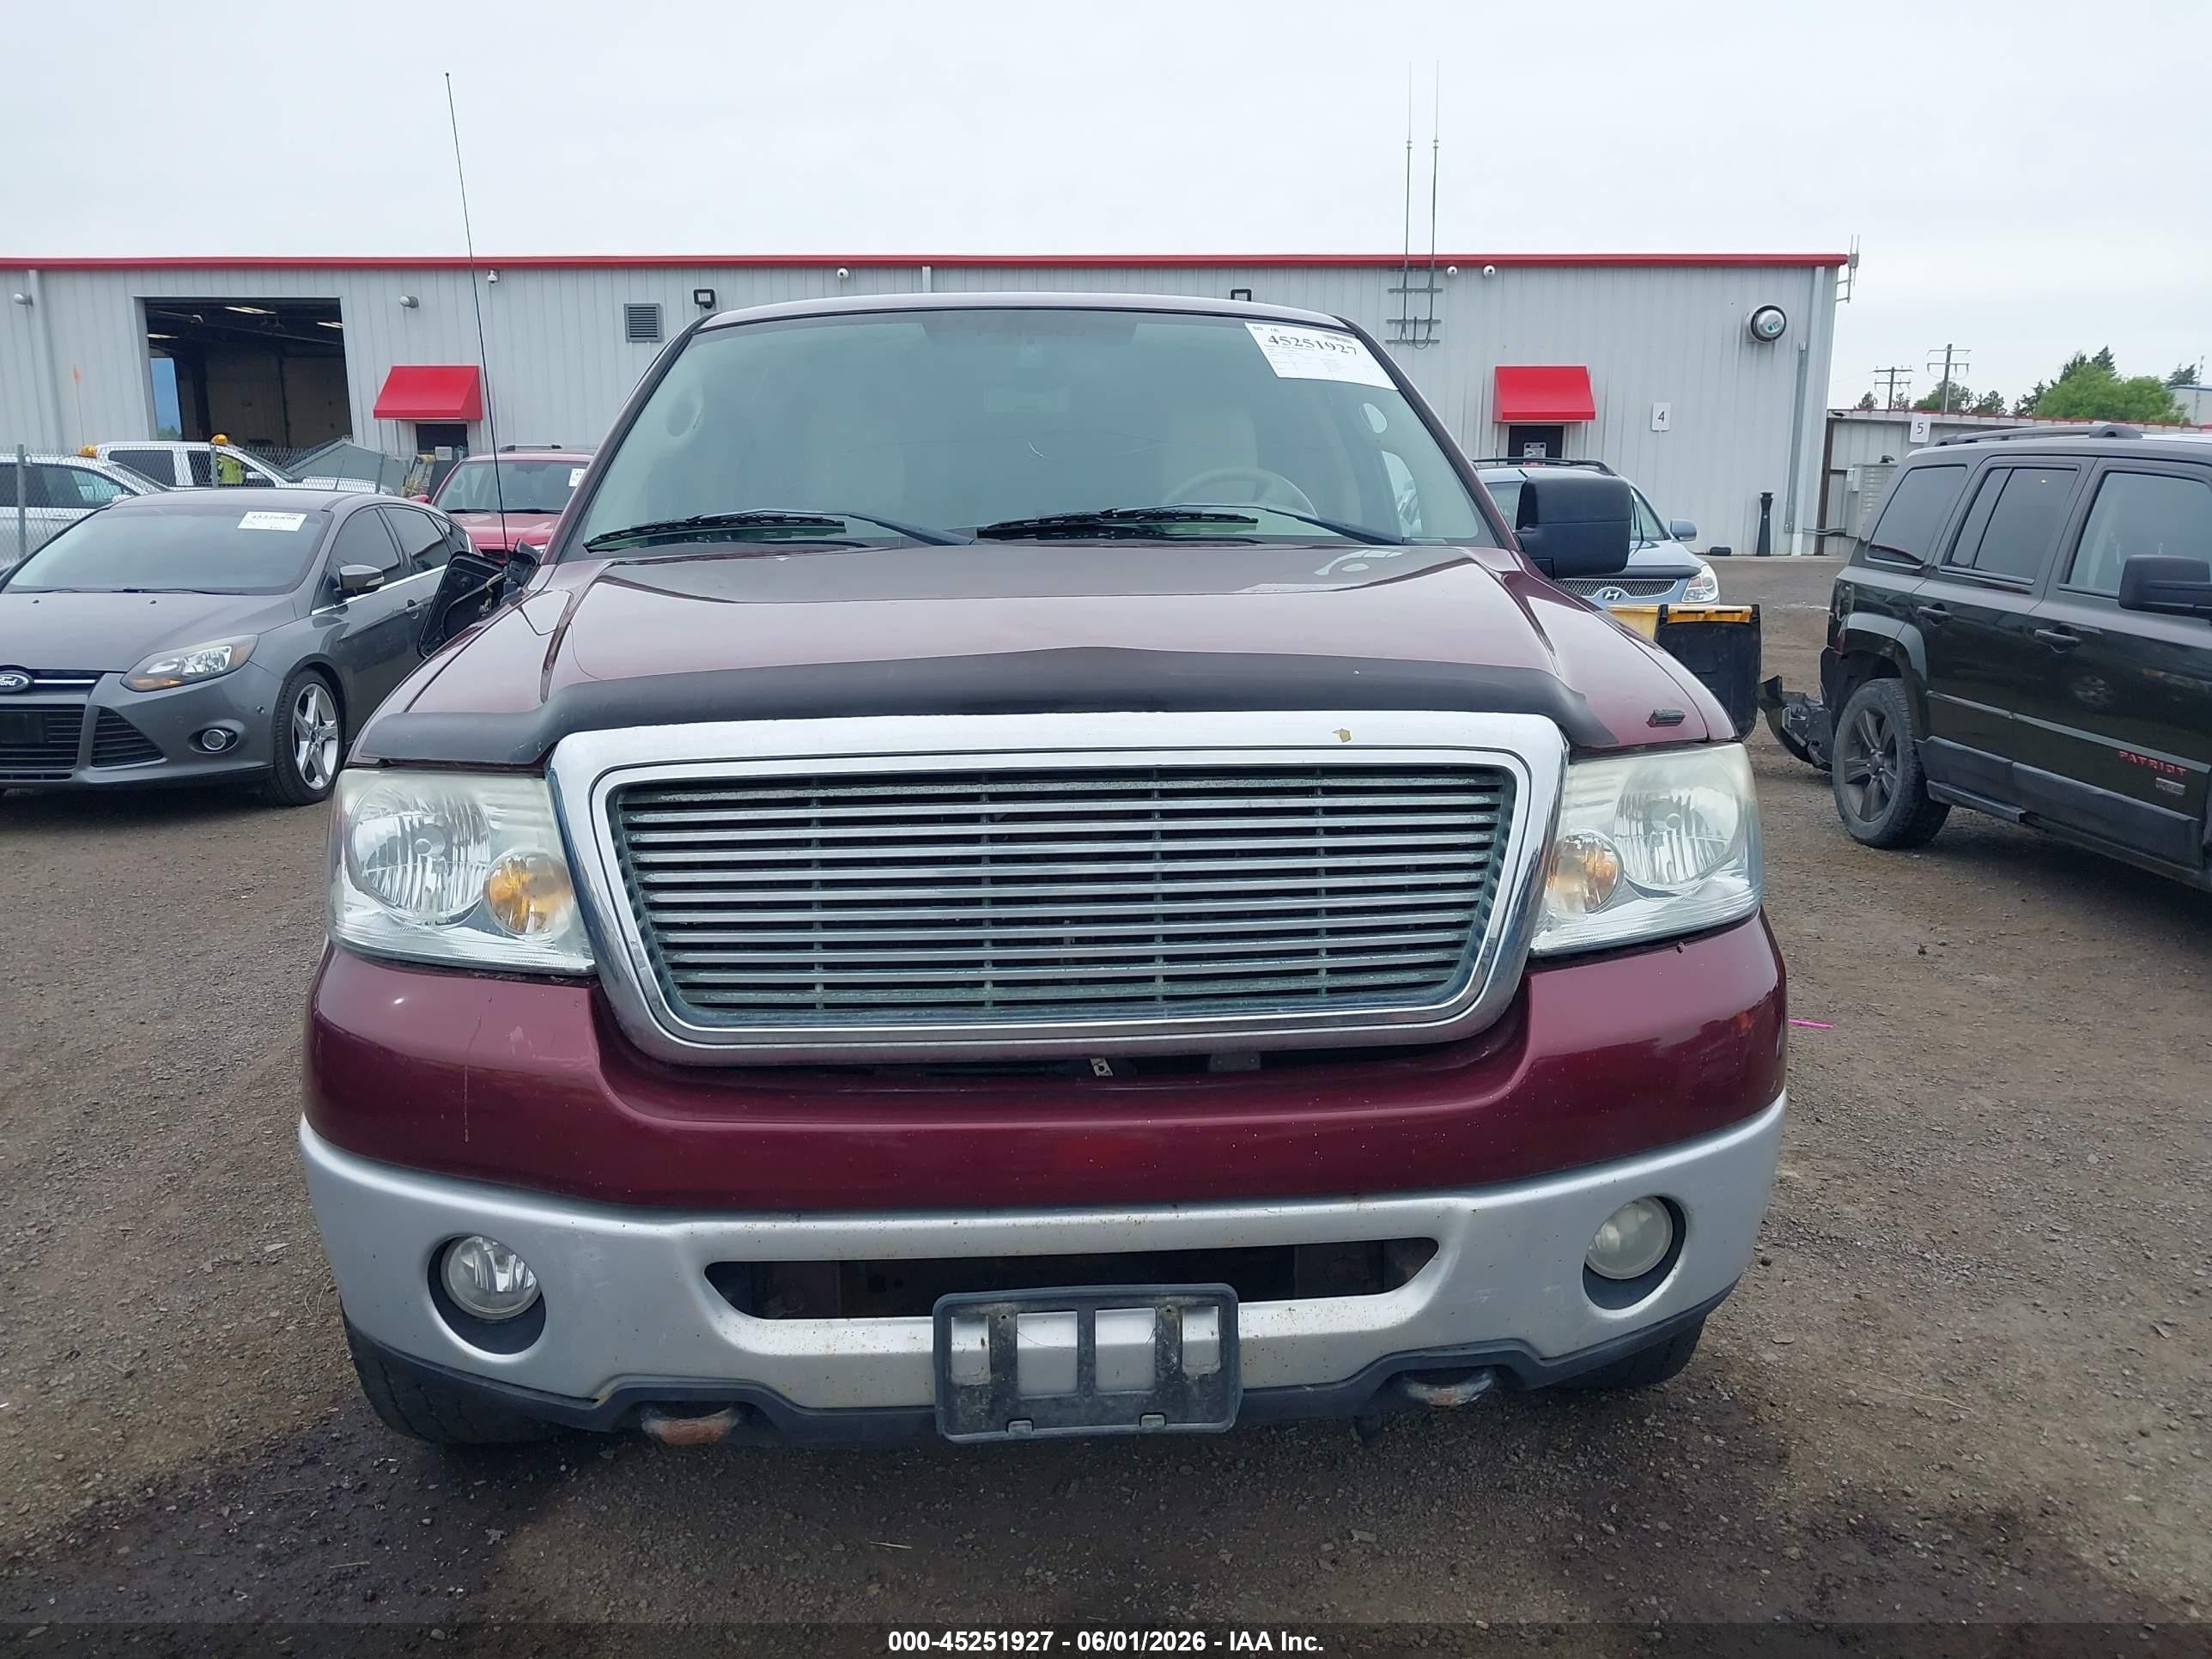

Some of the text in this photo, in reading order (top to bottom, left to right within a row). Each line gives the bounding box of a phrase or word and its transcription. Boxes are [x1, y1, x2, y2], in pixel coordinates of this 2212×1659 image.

[1268, 335, 1357, 355] 45251927
[1657, 410, 1665, 422] 4
[1917, 422, 1924, 434] 5
[2118, 750, 2186, 776] PATRIOT
